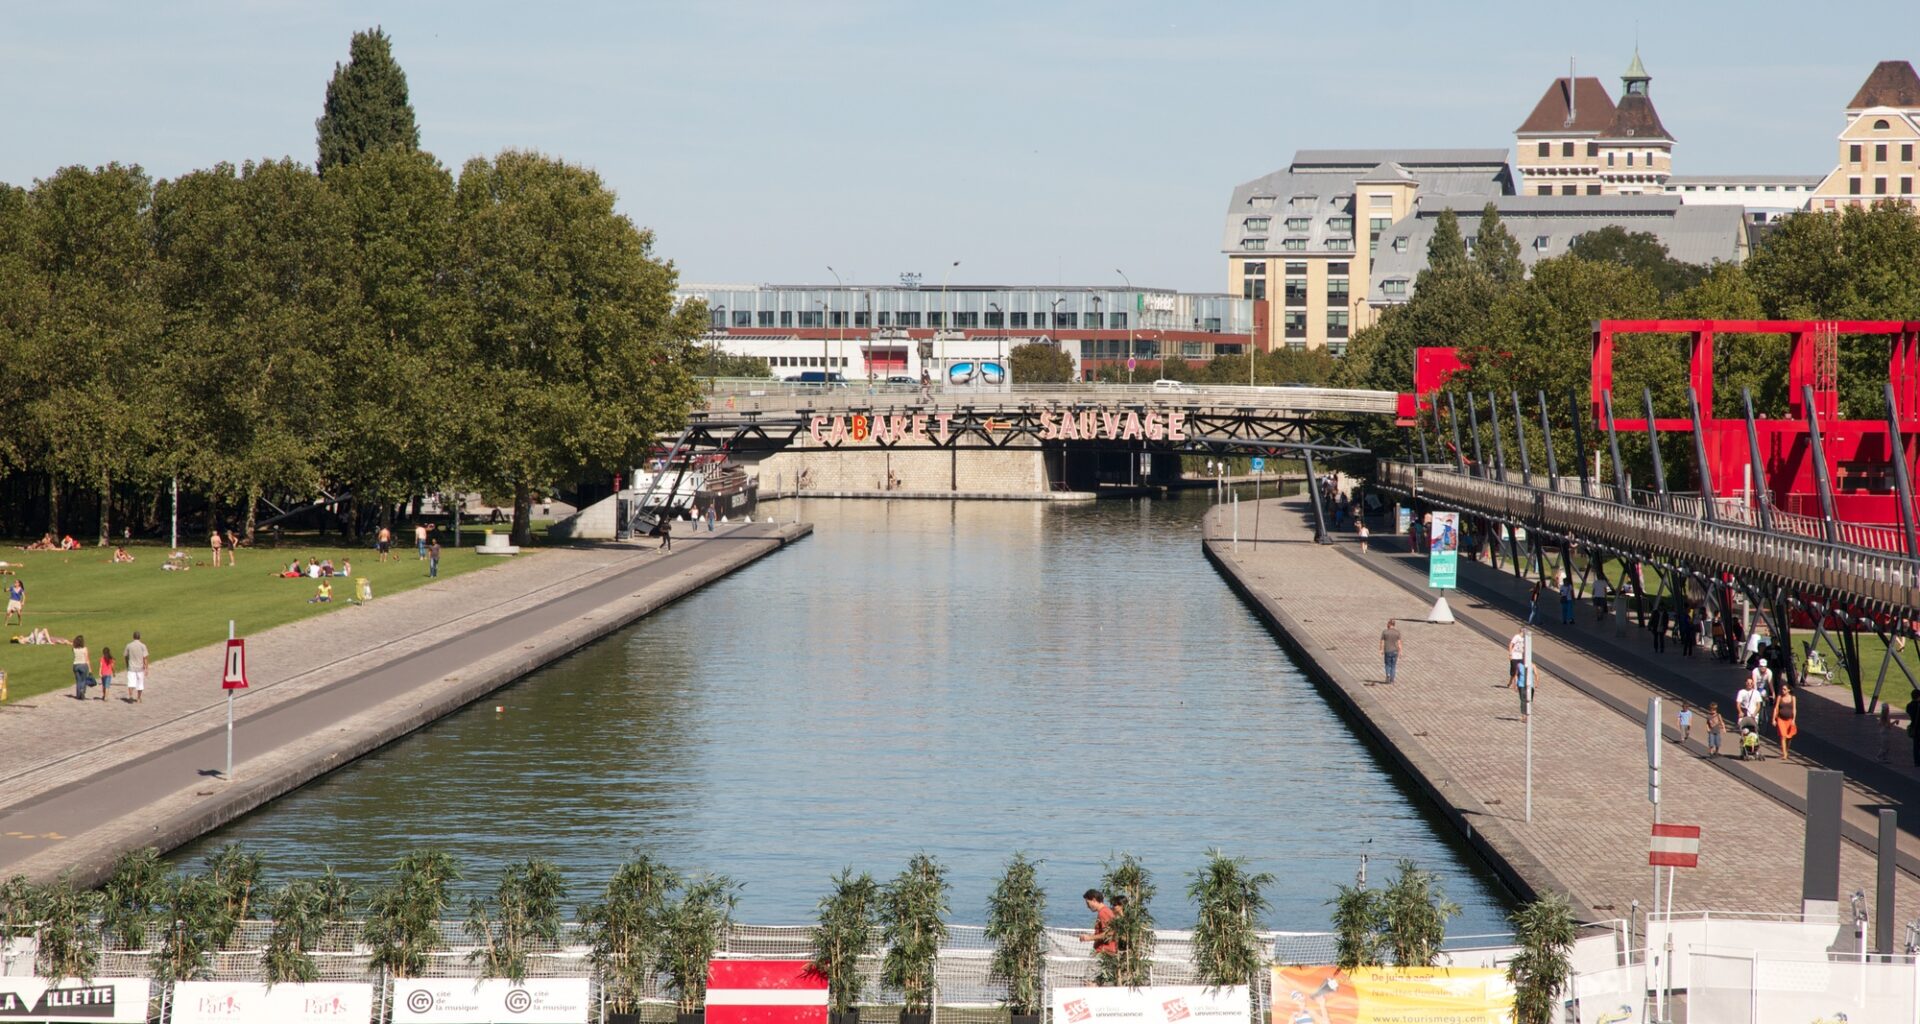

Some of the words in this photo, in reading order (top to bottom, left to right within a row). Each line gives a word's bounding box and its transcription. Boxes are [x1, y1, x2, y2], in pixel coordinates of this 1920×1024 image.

[811, 414, 954, 442] CABARET
[1040, 412, 1185, 440] SAUVAGE
[1372, 973, 1384, 981] De
[445, 1004, 479, 1012] musique
[543, 1004, 577, 1012] musique
[1372, 1015, 1486, 1024] www.tourisme93.com
